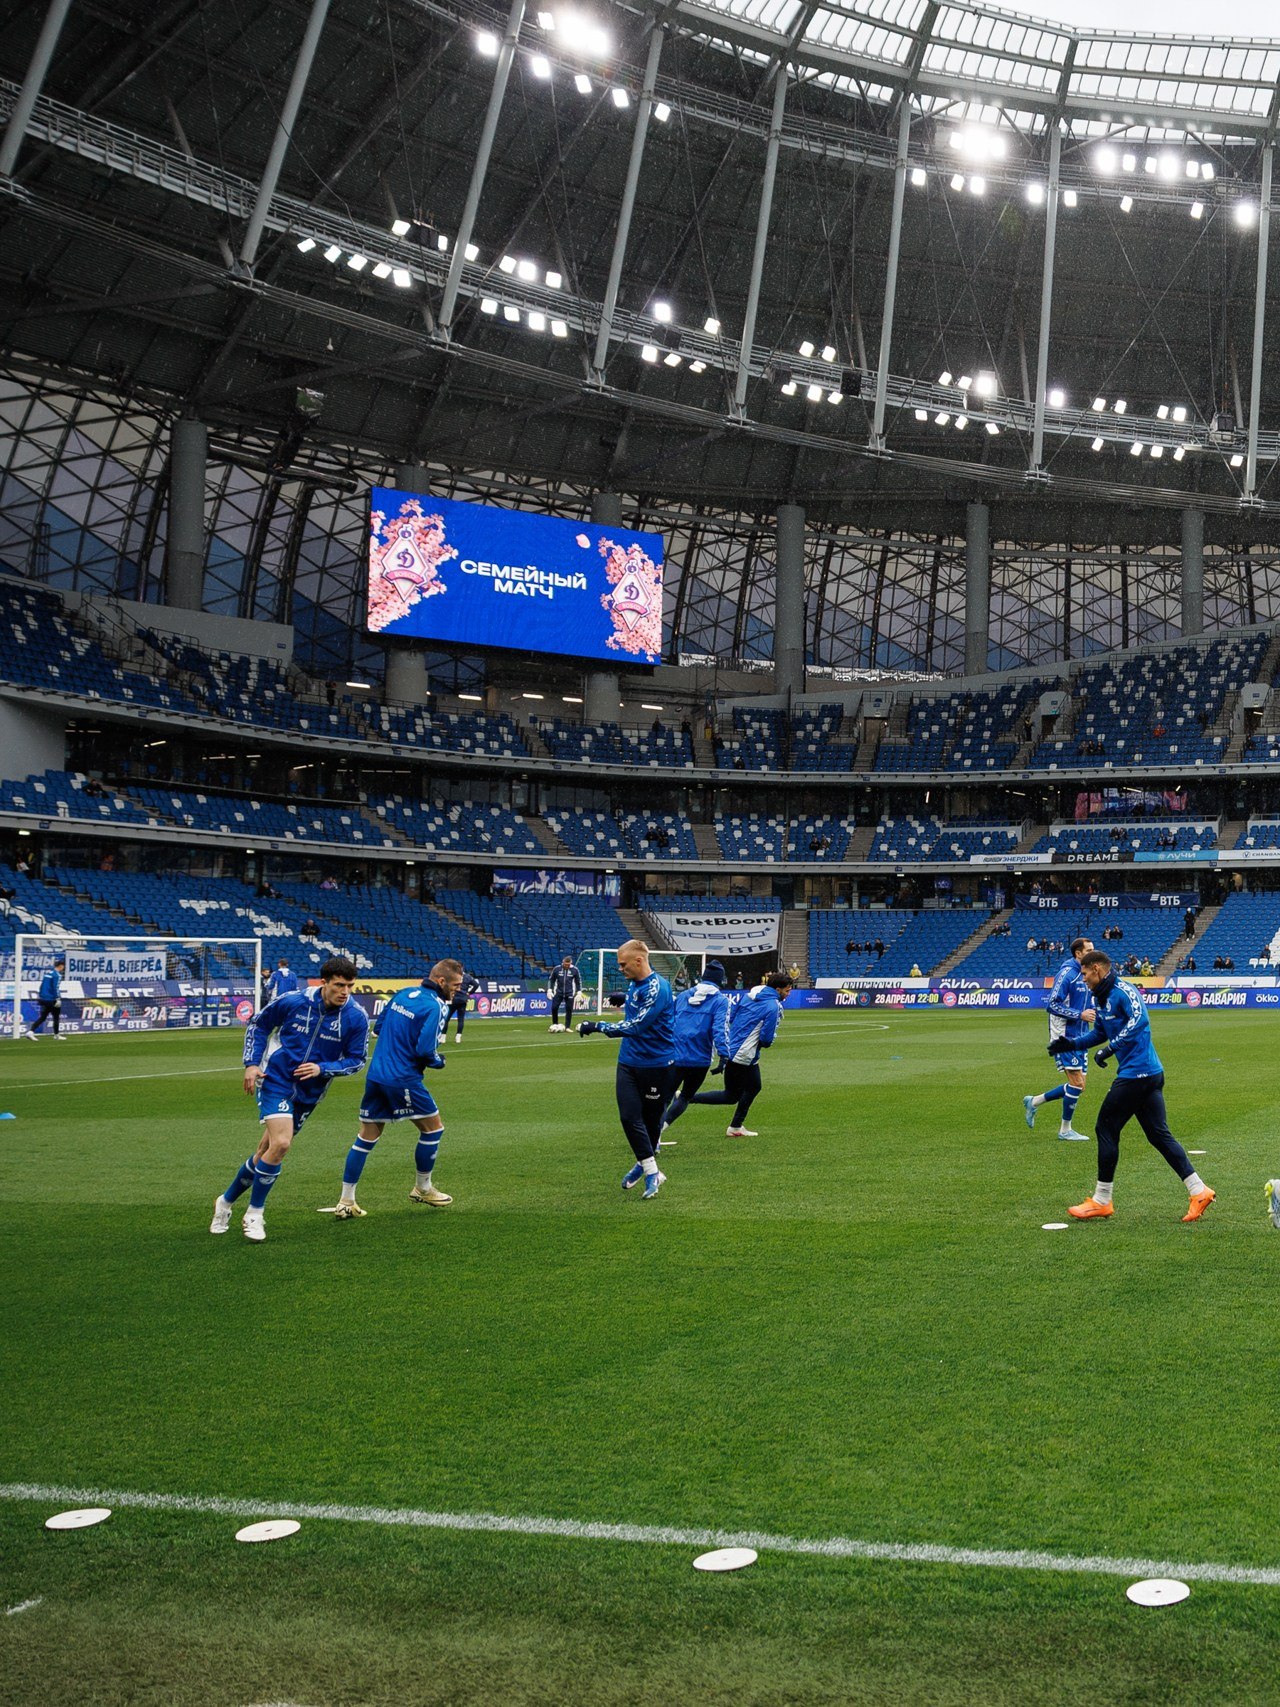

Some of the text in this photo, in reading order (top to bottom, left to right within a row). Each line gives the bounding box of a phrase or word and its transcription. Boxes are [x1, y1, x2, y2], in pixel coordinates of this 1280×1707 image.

[460, 559, 587, 590] СЕМЕЙНЫЙ
[494, 578, 554, 599] МАТЧ
[1068, 854, 1119, 862] DREAME
[1039, 898, 1058, 908] ВТБ
[1099, 897, 1119, 907] ВТБ
[1160, 896, 1180, 905] ВТБ
[675, 917, 775, 926] BetBoom
[729, 942, 773, 954] ВТБ
[69, 956, 162, 974] ВПЕРЁД, ВПЕРЁД
[490, 997, 525, 1012] БАВАРИЯ
[835, 993, 939, 1005] ПСЖ 28 АПРЕЛЯ 22:00
[957, 993, 1000, 1006] БАВАРИЯ
[1159, 993, 1182, 1004] 22:00
[1202, 993, 1247, 1005] БАВАРИЯ
[82, 1006, 118, 1019] ПСЖ
[390, 1001, 416, 1020] BetBoom
[128, 1019, 149, 1029] ВТБ
[190, 1009, 231, 1027] ВТБ
[58, 1021, 80, 1031] ВТБ
[93, 1020, 115, 1030] ВТБ
